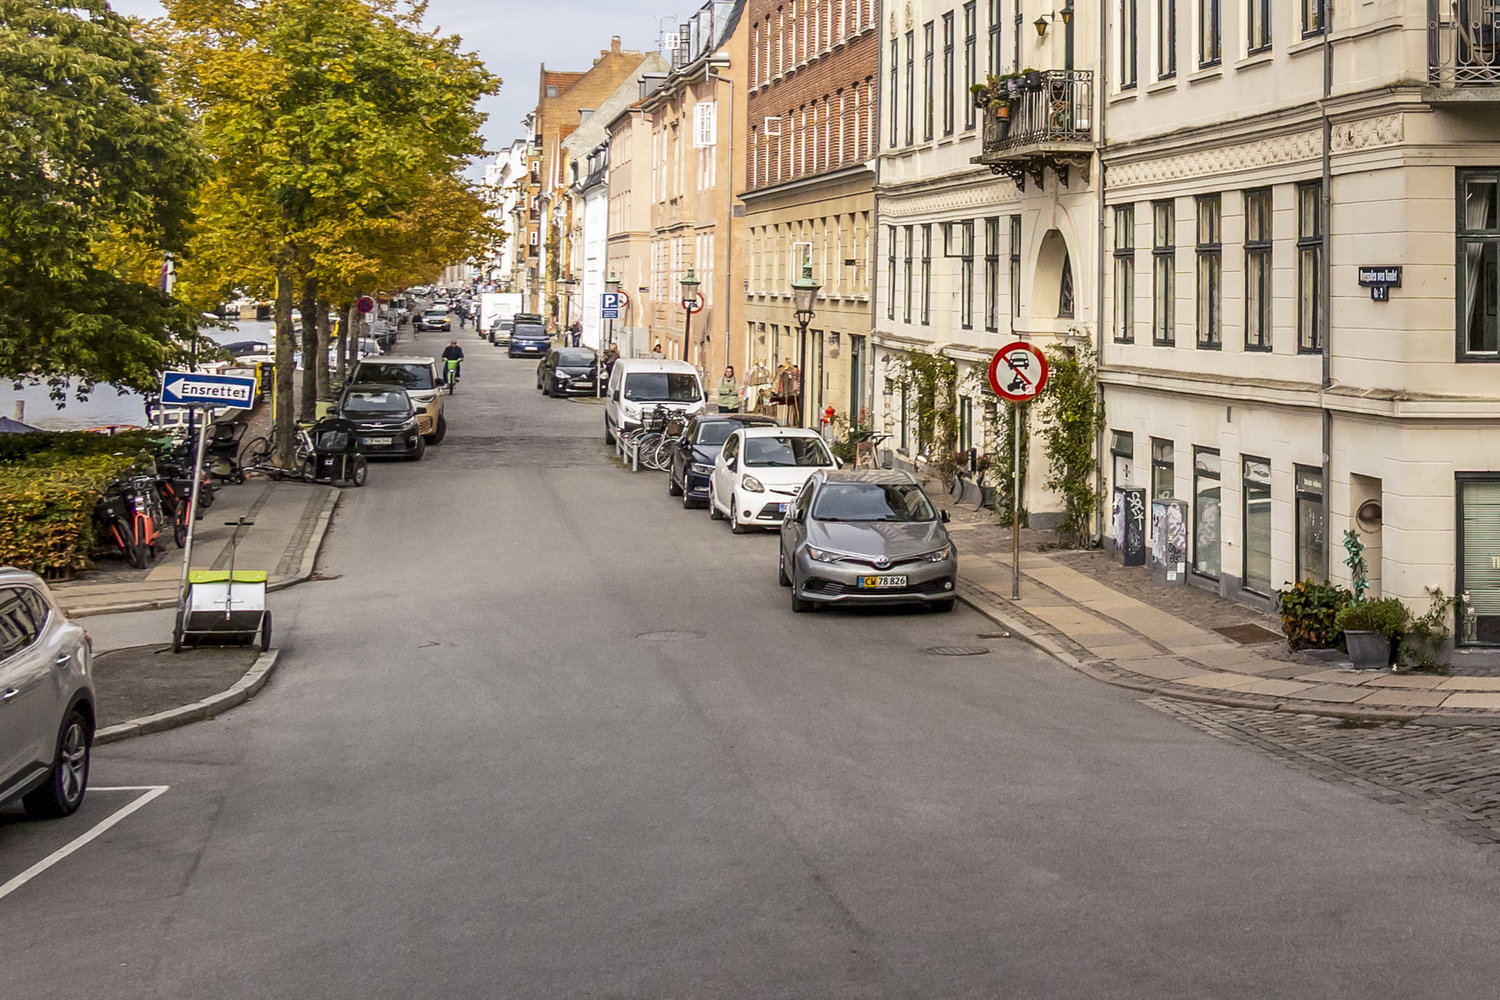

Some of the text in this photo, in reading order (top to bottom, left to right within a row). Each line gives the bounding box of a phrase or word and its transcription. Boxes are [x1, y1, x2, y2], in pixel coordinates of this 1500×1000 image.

[605, 294, 616, 308] P
[181, 382, 247, 399] Ensrettet
[864, 577, 905, 585] CW 78 826
